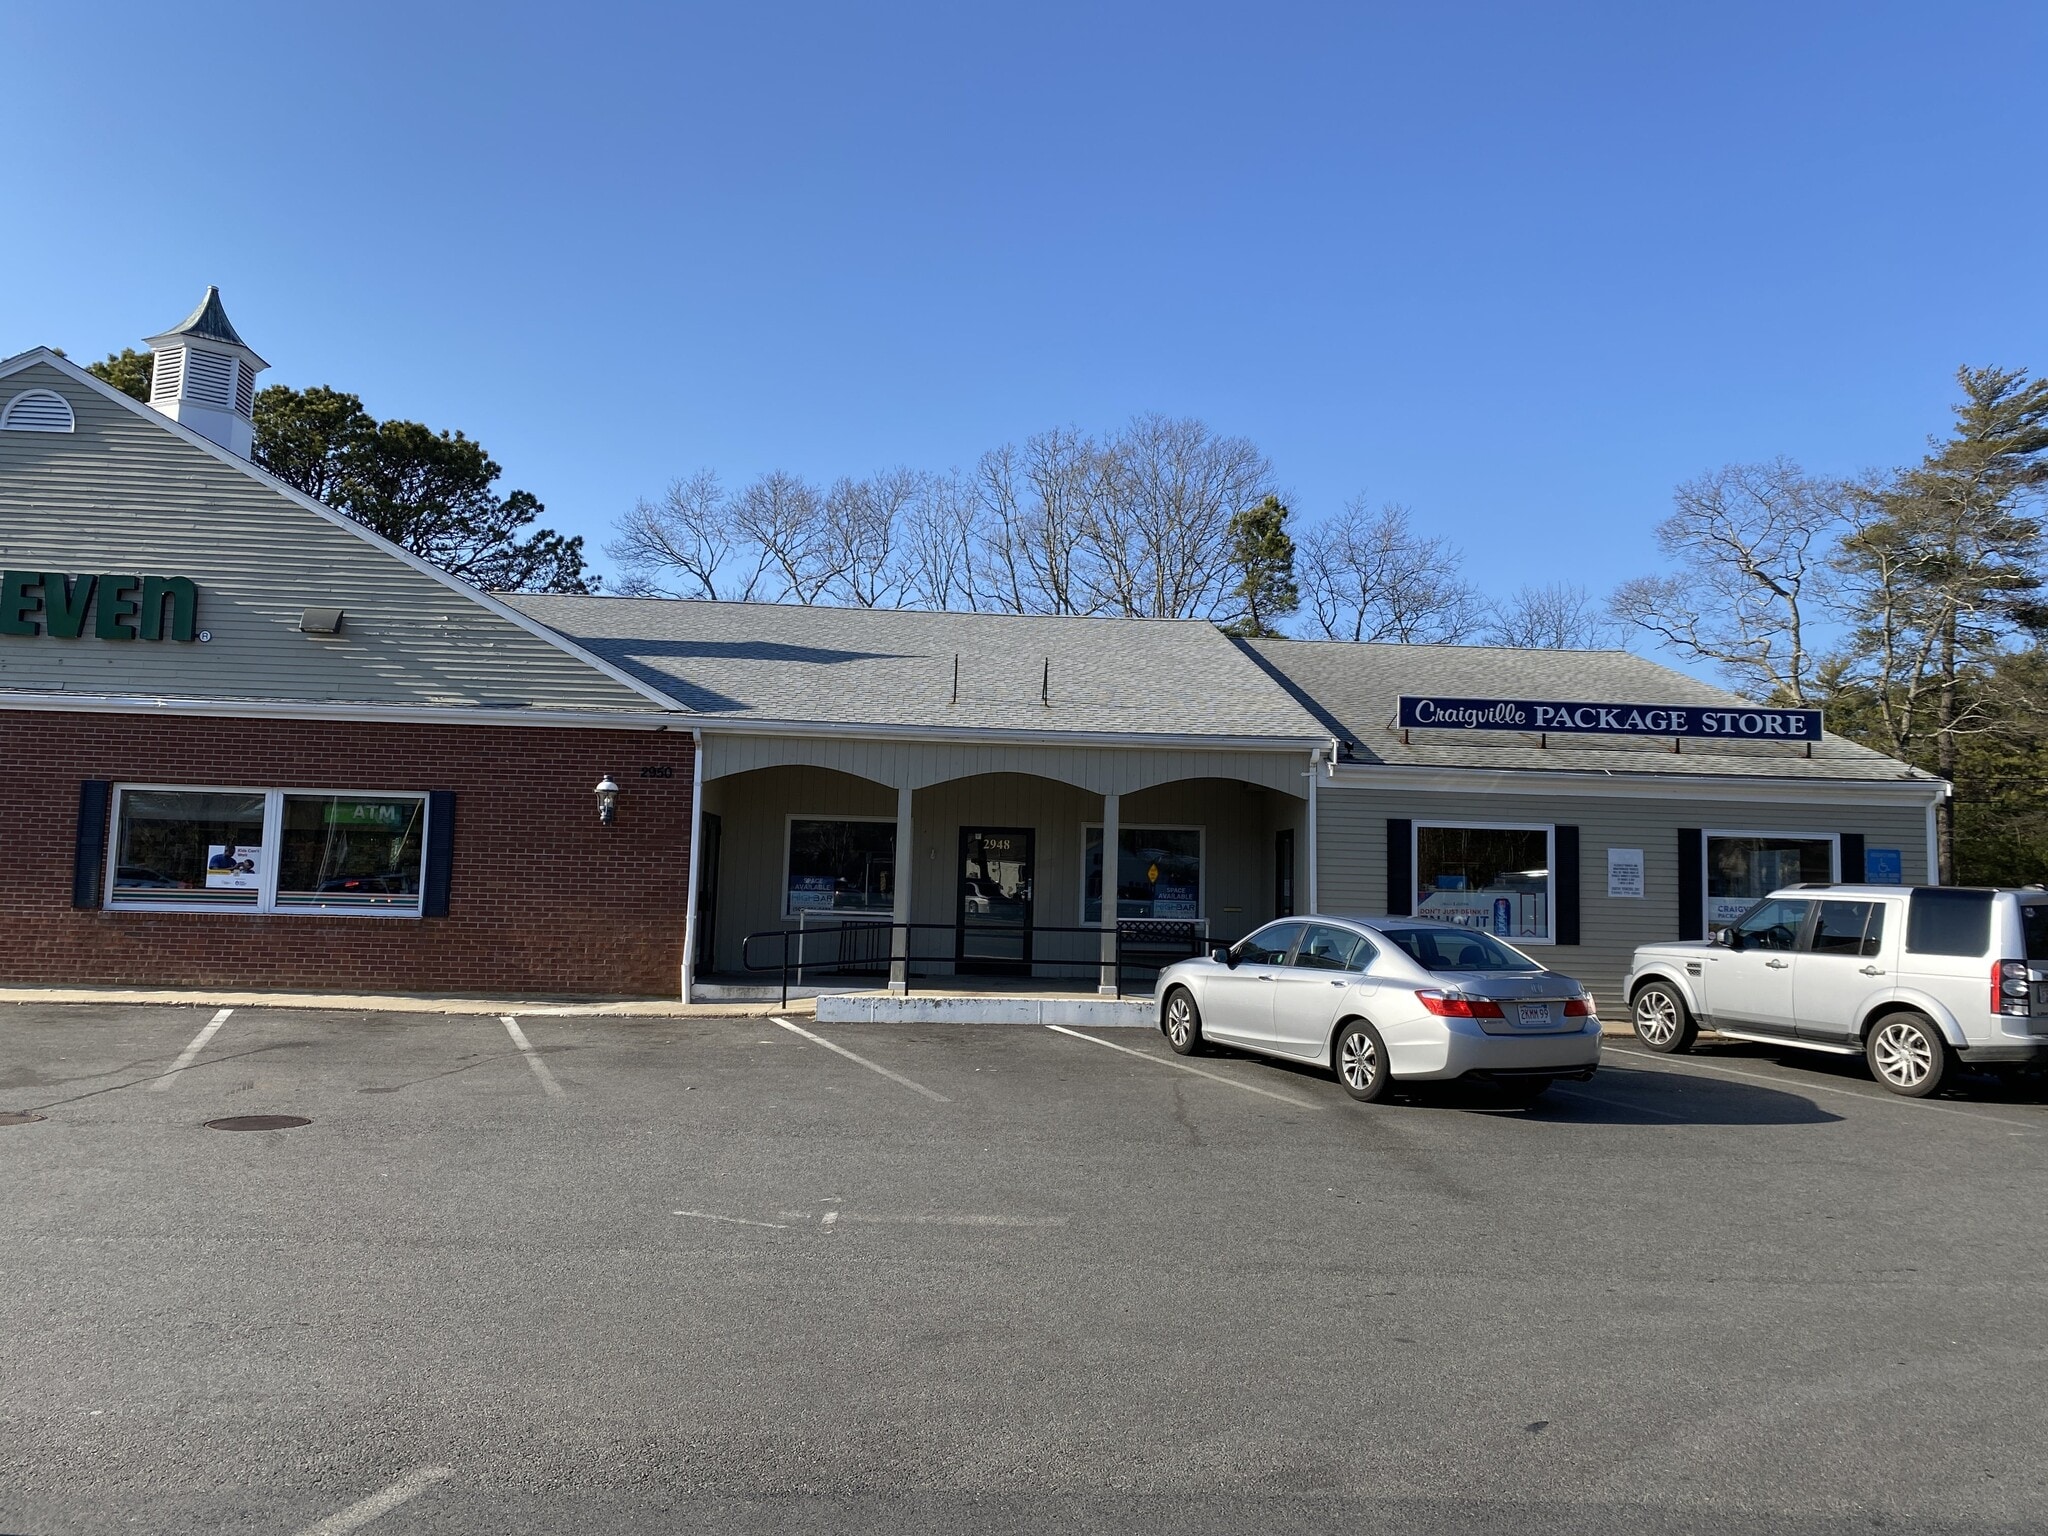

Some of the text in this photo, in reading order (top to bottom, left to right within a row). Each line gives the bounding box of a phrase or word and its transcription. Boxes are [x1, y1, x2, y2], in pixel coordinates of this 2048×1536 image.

[1415, 699, 1808, 736] Craigville PACKAGE STORE
[640, 766, 673, 779] 2950
[352, 804, 396, 820] ATM
[983, 839, 1010, 850] 2948
[794, 883, 831, 891] AVAILABLE
[1460, 908, 1481, 916] DRINK
[1717, 905, 1751, 913] CRAIGV
[1475, 915, 1490, 928] IT
[1520, 1008, 1549, 1020] 2KMM 99
